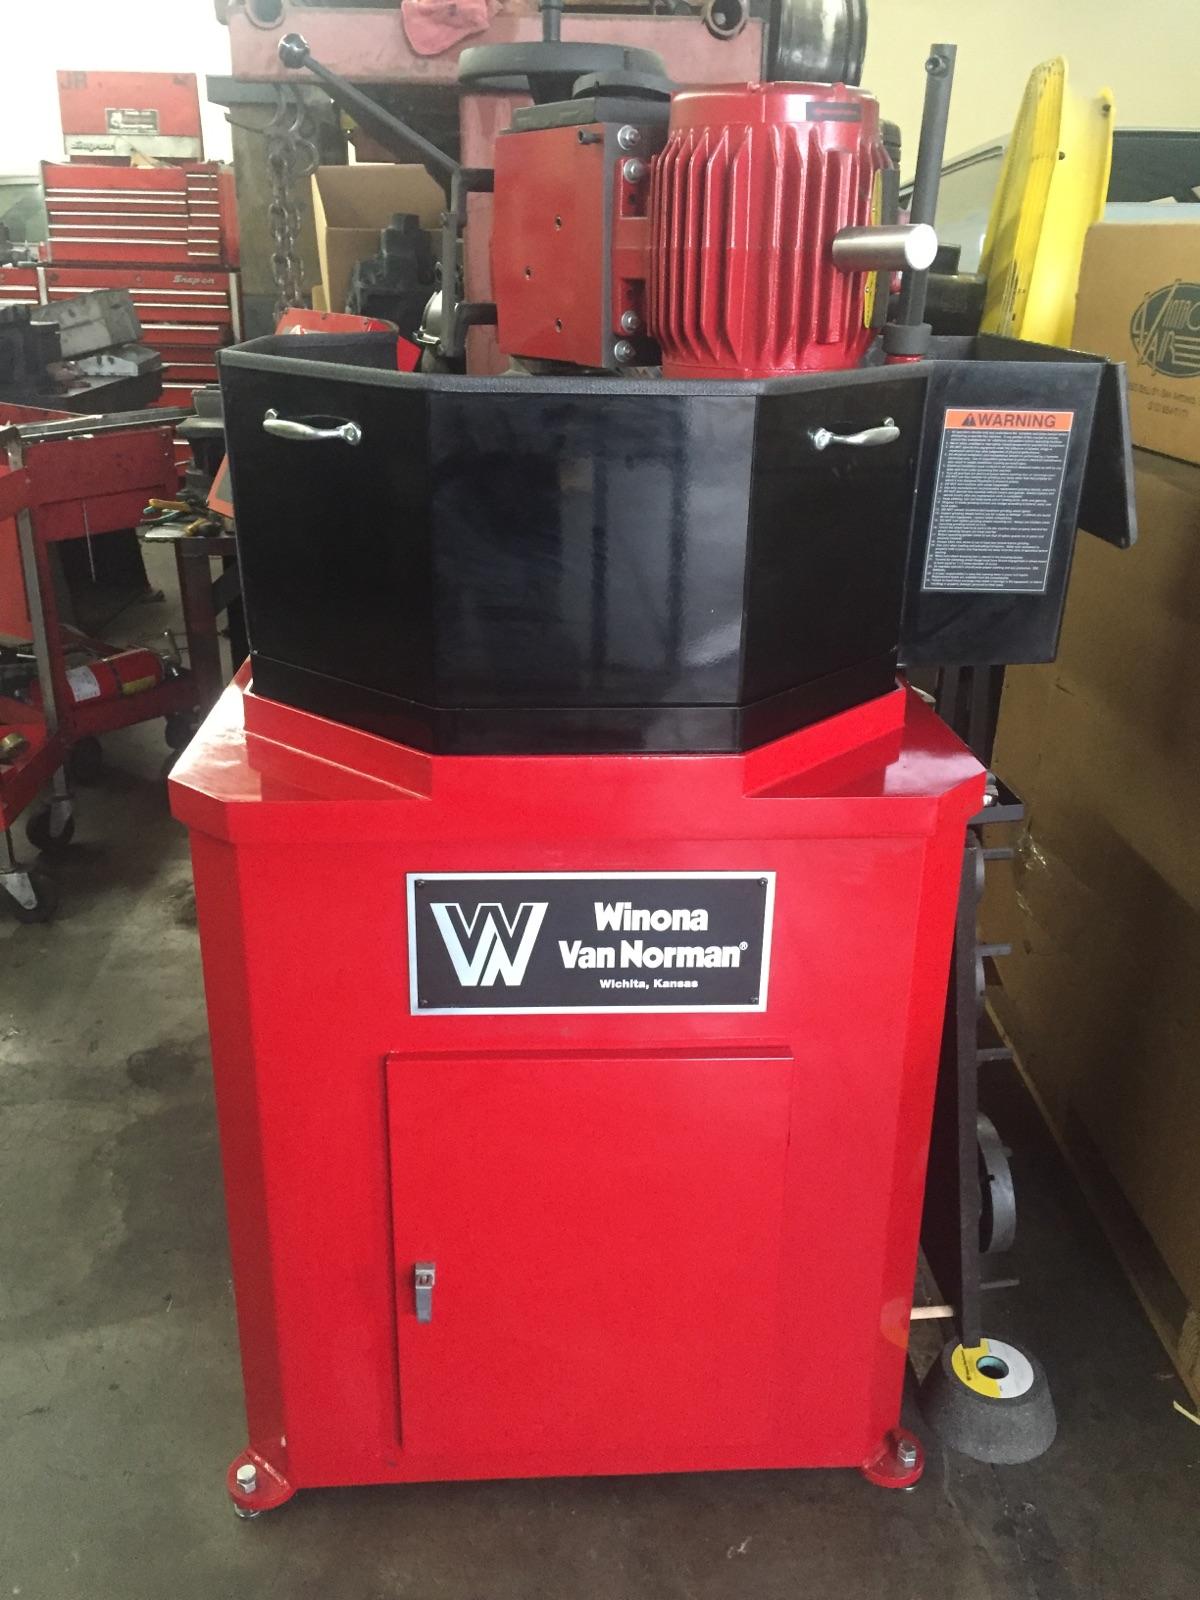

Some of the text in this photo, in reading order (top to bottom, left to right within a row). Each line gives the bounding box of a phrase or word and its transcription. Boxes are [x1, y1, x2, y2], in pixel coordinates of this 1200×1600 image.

[978, 413, 1056, 428] WARNING
[594, 902, 708, 931] Winona
[558, 940, 615, 969] Van
[599, 978, 698, 990] Wichita, Kansas
